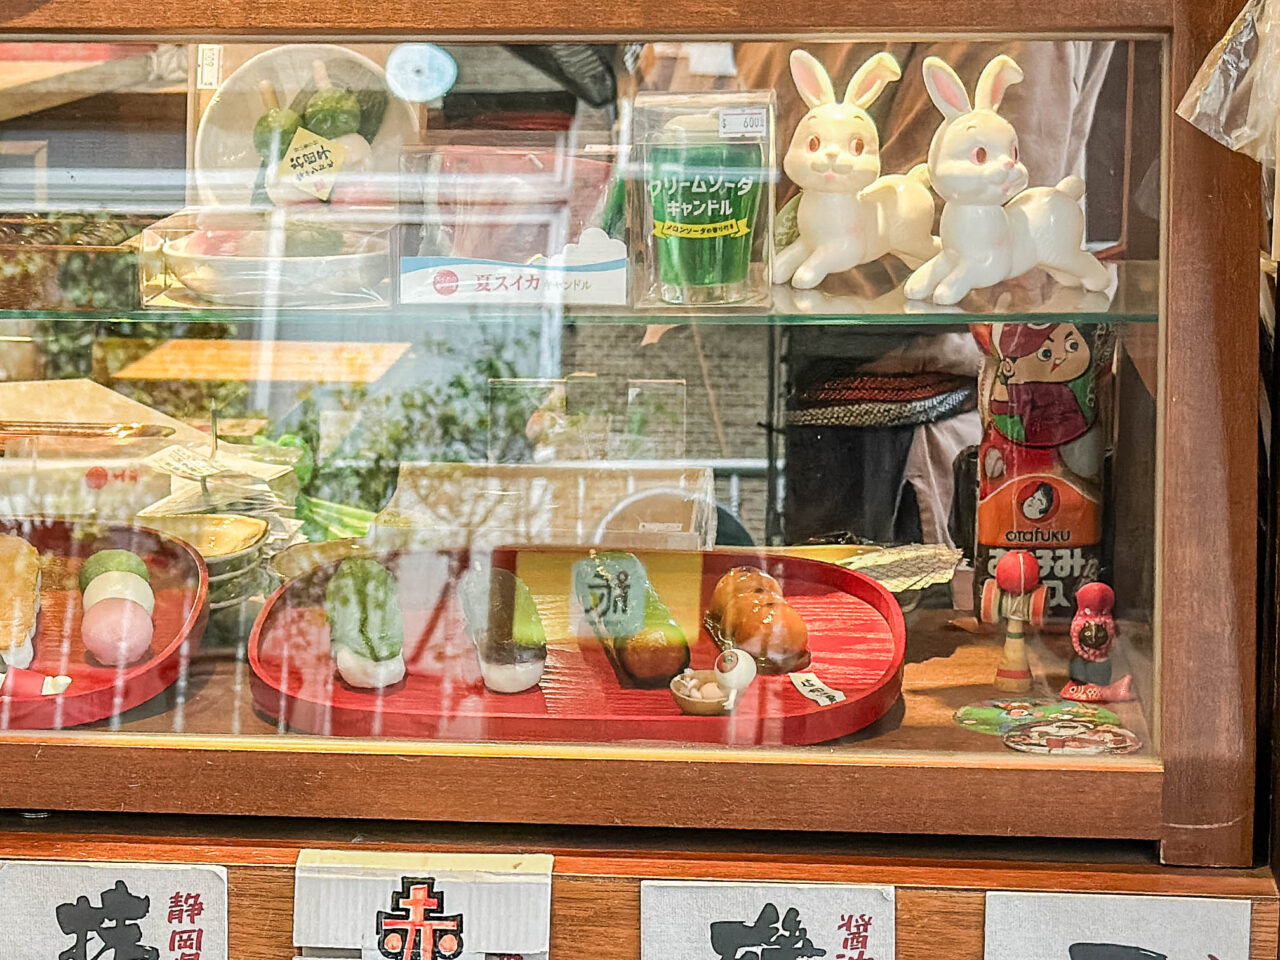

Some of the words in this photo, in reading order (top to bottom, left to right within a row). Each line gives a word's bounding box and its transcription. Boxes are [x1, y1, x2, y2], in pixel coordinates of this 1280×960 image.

[647, 174, 755, 198] クリームソーダ
[666, 199, 734, 217] キャンドル
[474, 273, 541, 292] 夏スイカ
